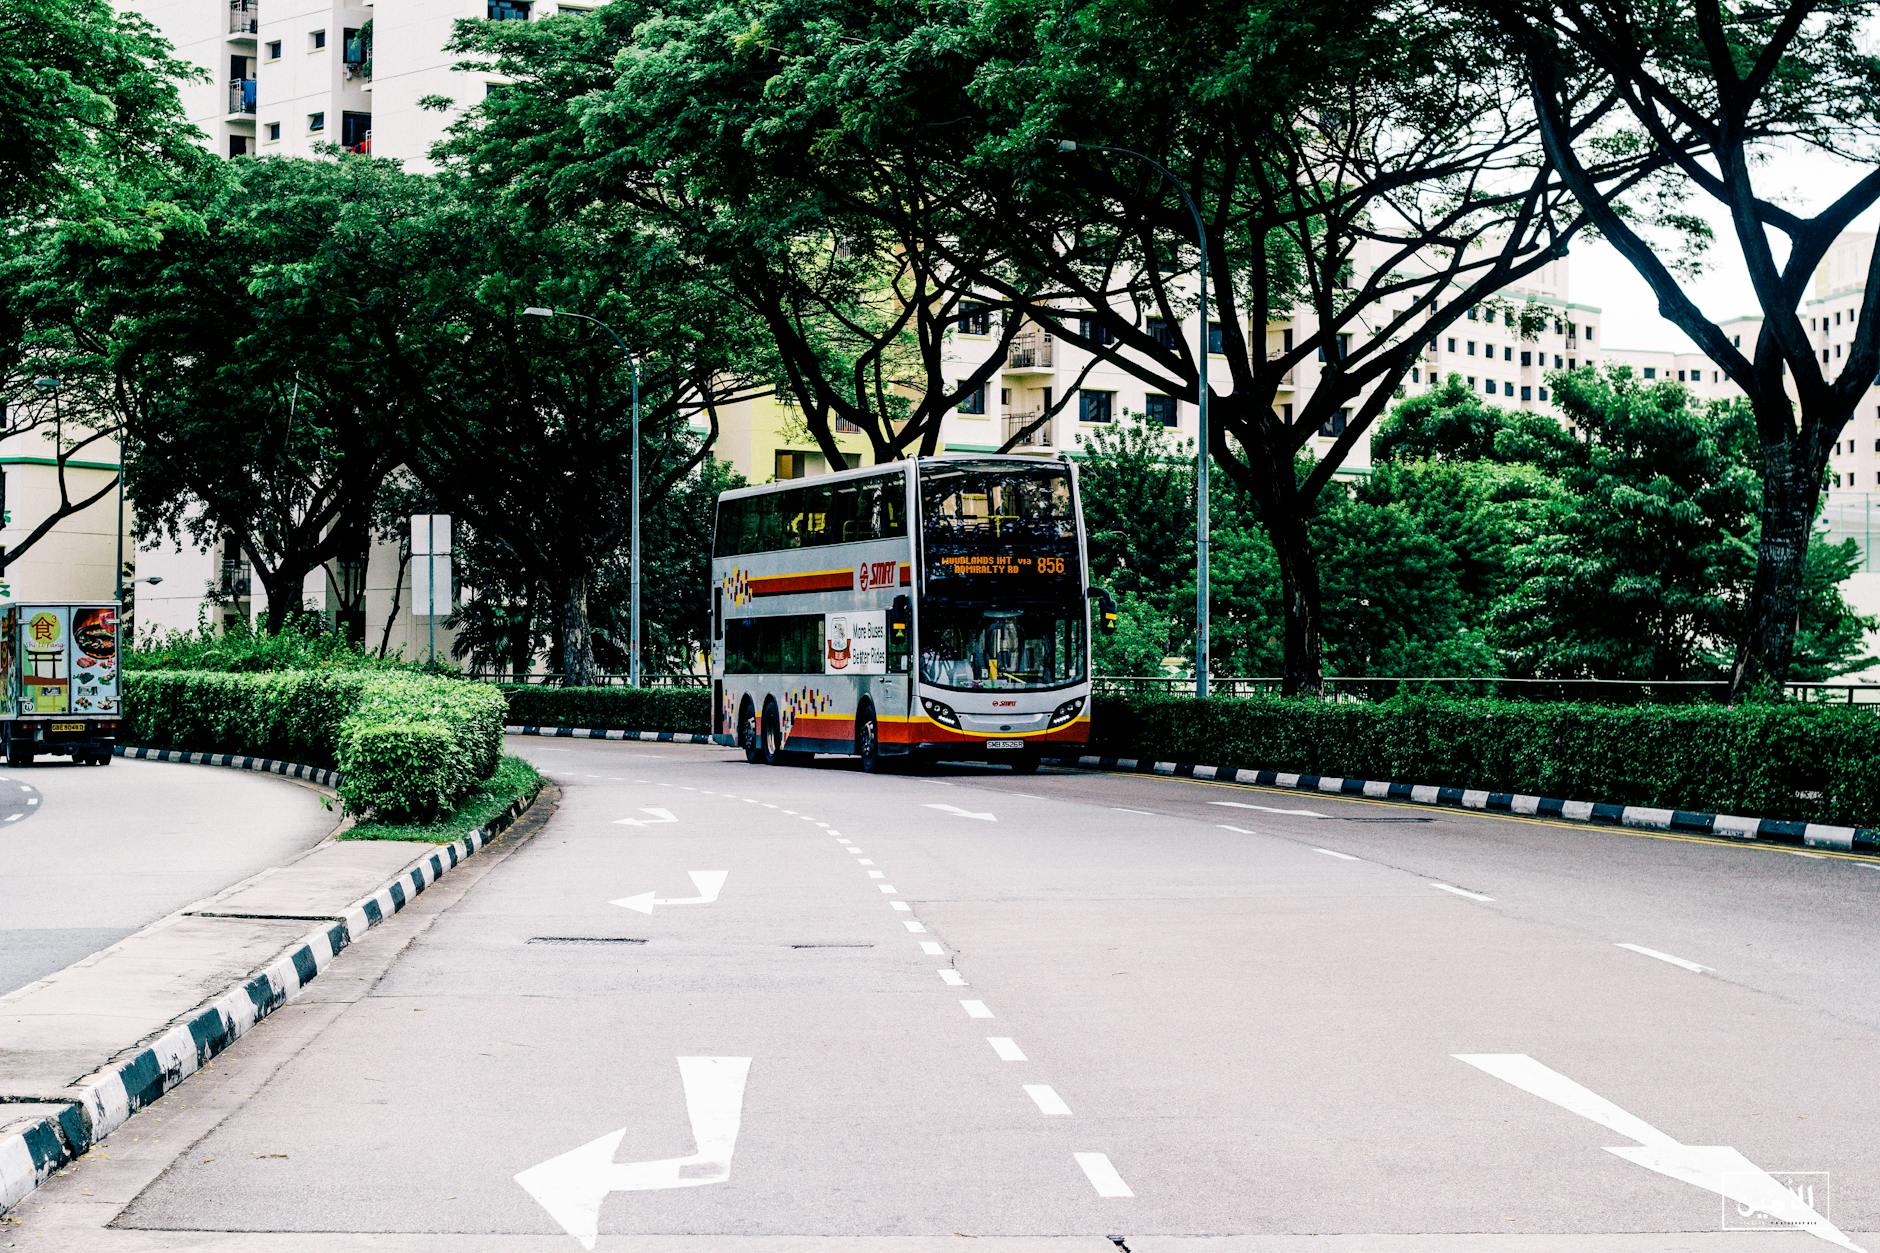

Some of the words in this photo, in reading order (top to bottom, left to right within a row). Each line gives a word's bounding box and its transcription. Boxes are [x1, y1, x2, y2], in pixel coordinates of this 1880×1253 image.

[869, 561, 896, 586] SMRT
[954, 565, 1006, 574] ADMIRALTY
[1007, 565, 1020, 574] RD
[1037, 557, 1065, 573] 856
[853, 623, 867, 640] More
[868, 622, 884, 639] Buses
[853, 648, 870, 665] Better
[870, 647, 885, 665] Rides
